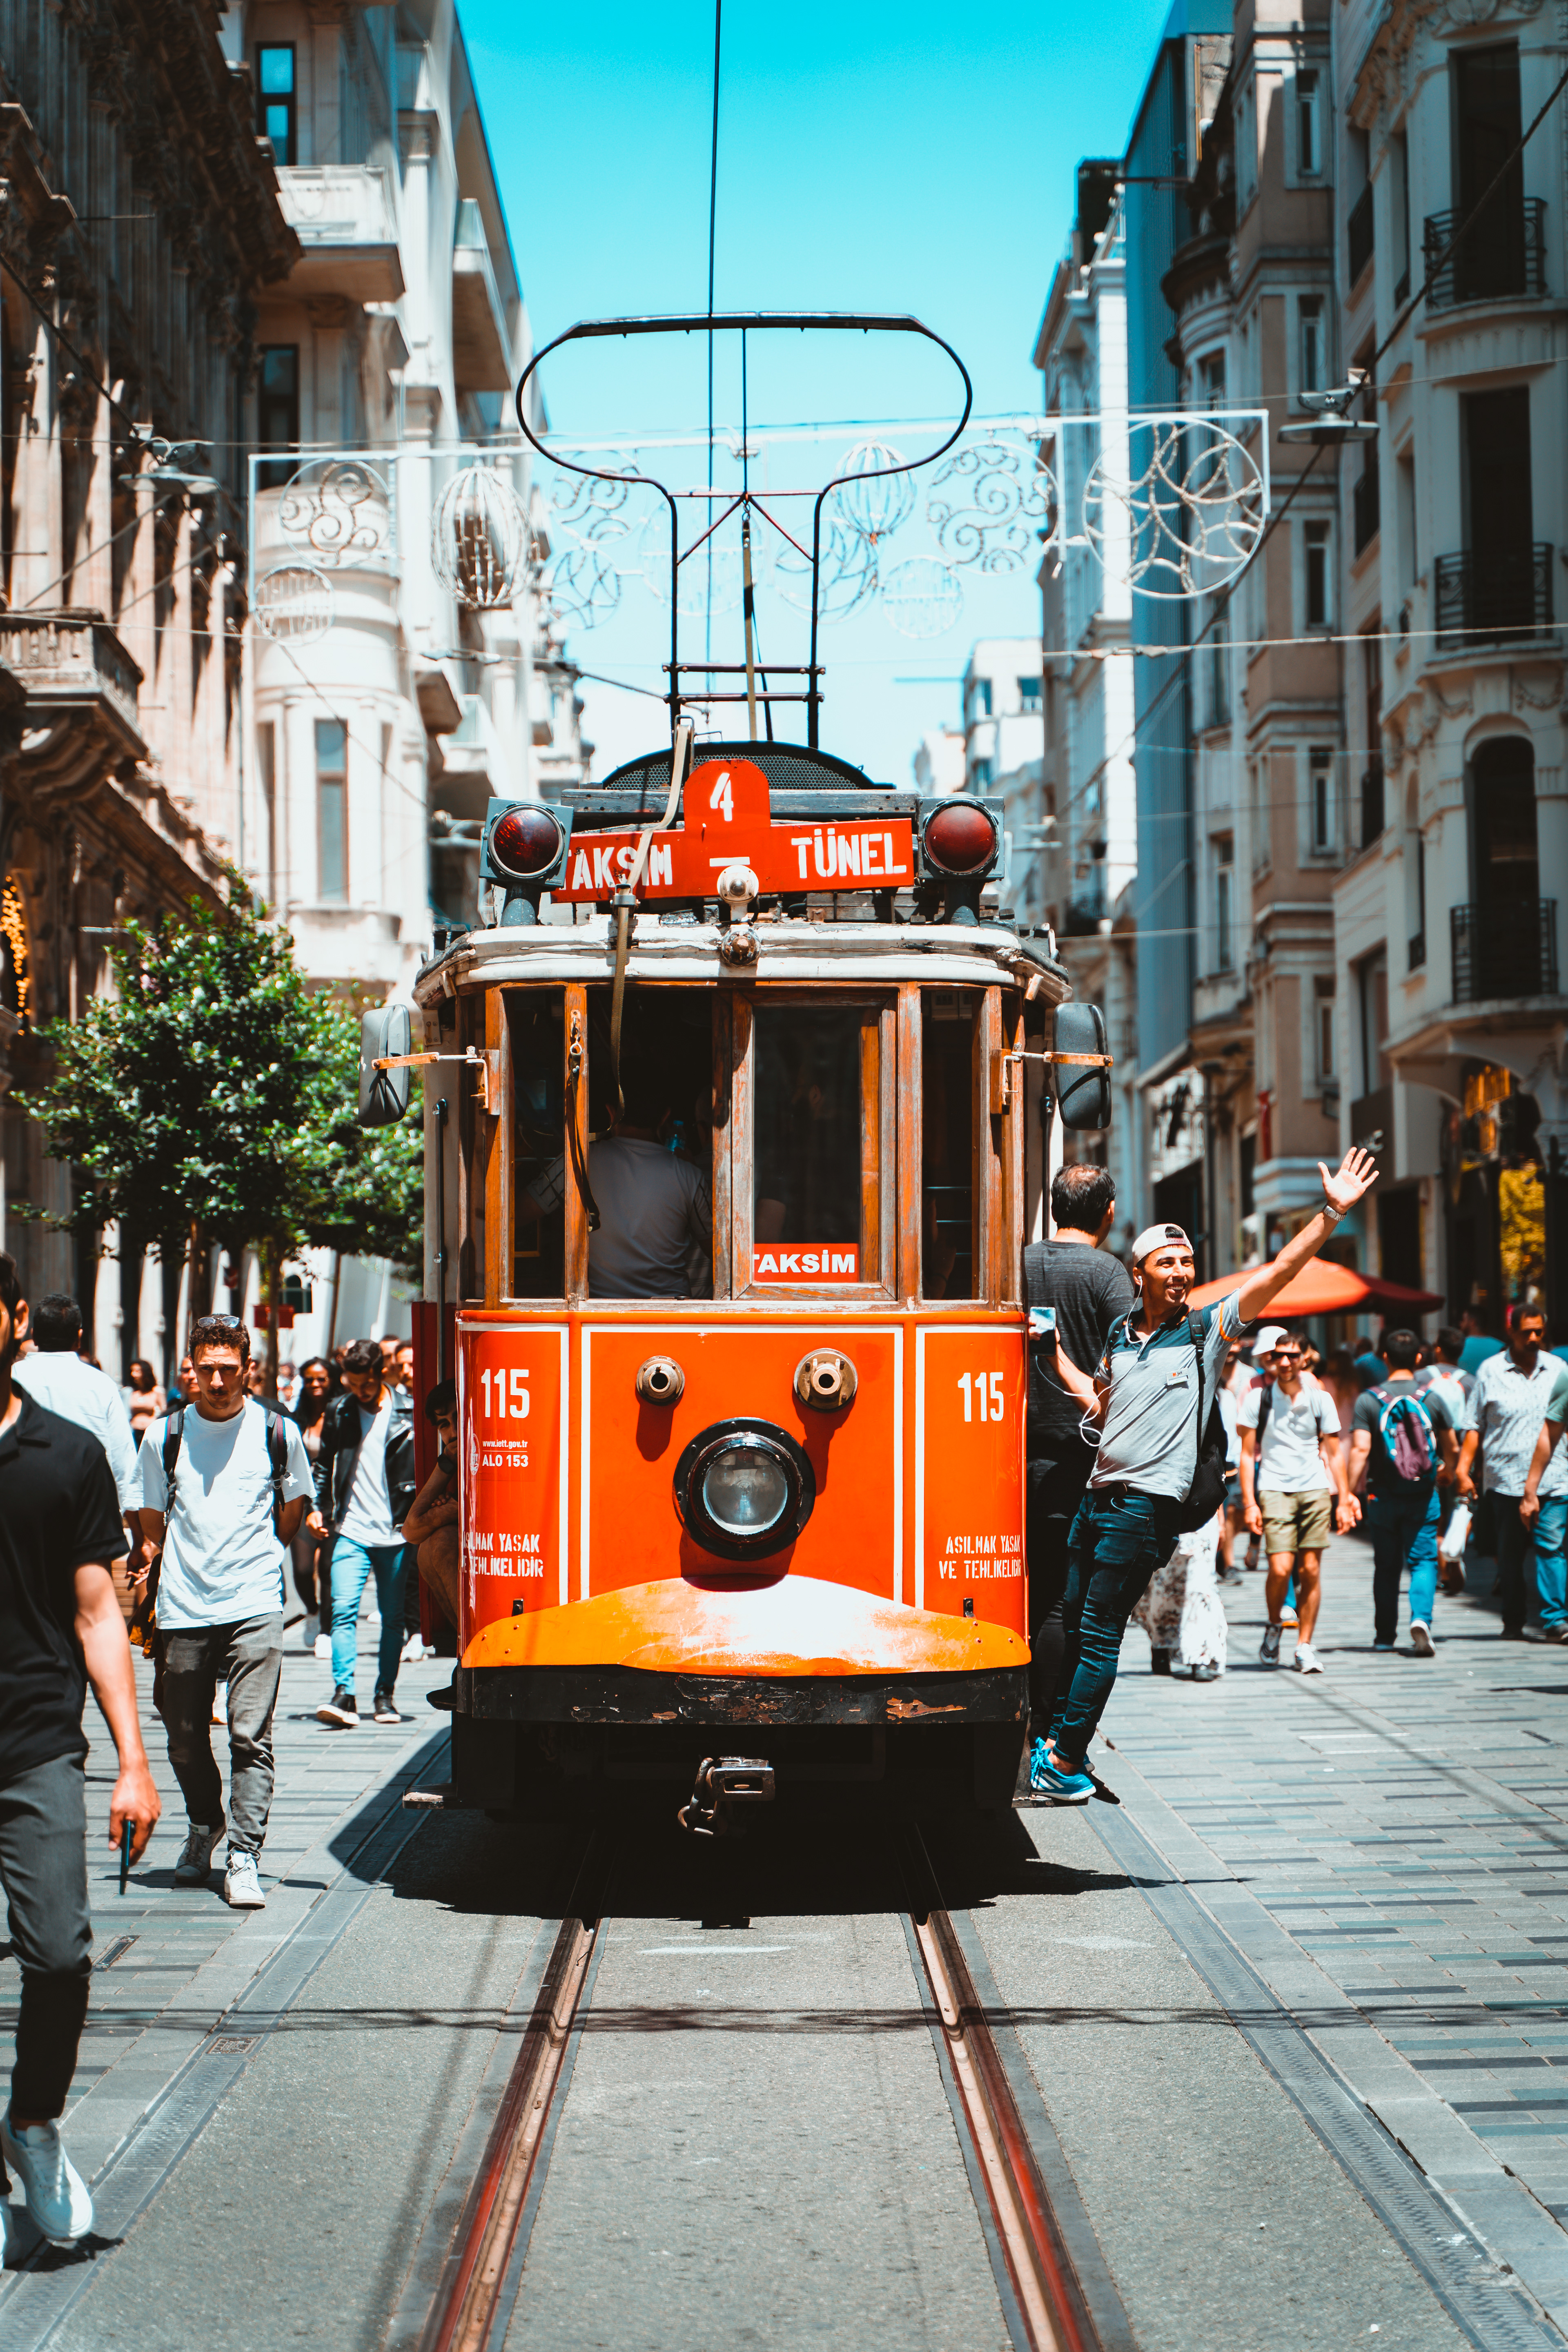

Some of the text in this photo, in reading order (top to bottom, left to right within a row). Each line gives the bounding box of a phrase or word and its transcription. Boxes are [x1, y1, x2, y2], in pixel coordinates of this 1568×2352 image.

[710, 772, 734, 822] 4
[559, 844, 673, 890] AKSM
[791, 828, 906, 879] TÜNEL
[753, 1250, 855, 1273] AKSİM
[481, 1368, 530, 1419] 115
[957, 1372, 1004, 1422] 115
[482, 1439, 528, 1450] www.iett.gov.tr
[482, 1454, 528, 1467] ALO 153
[499, 1533, 540, 1553] YASAK
[946, 1535, 1020, 1554] ASILMAK YASAK
[939, 1560, 957, 1579] VE
